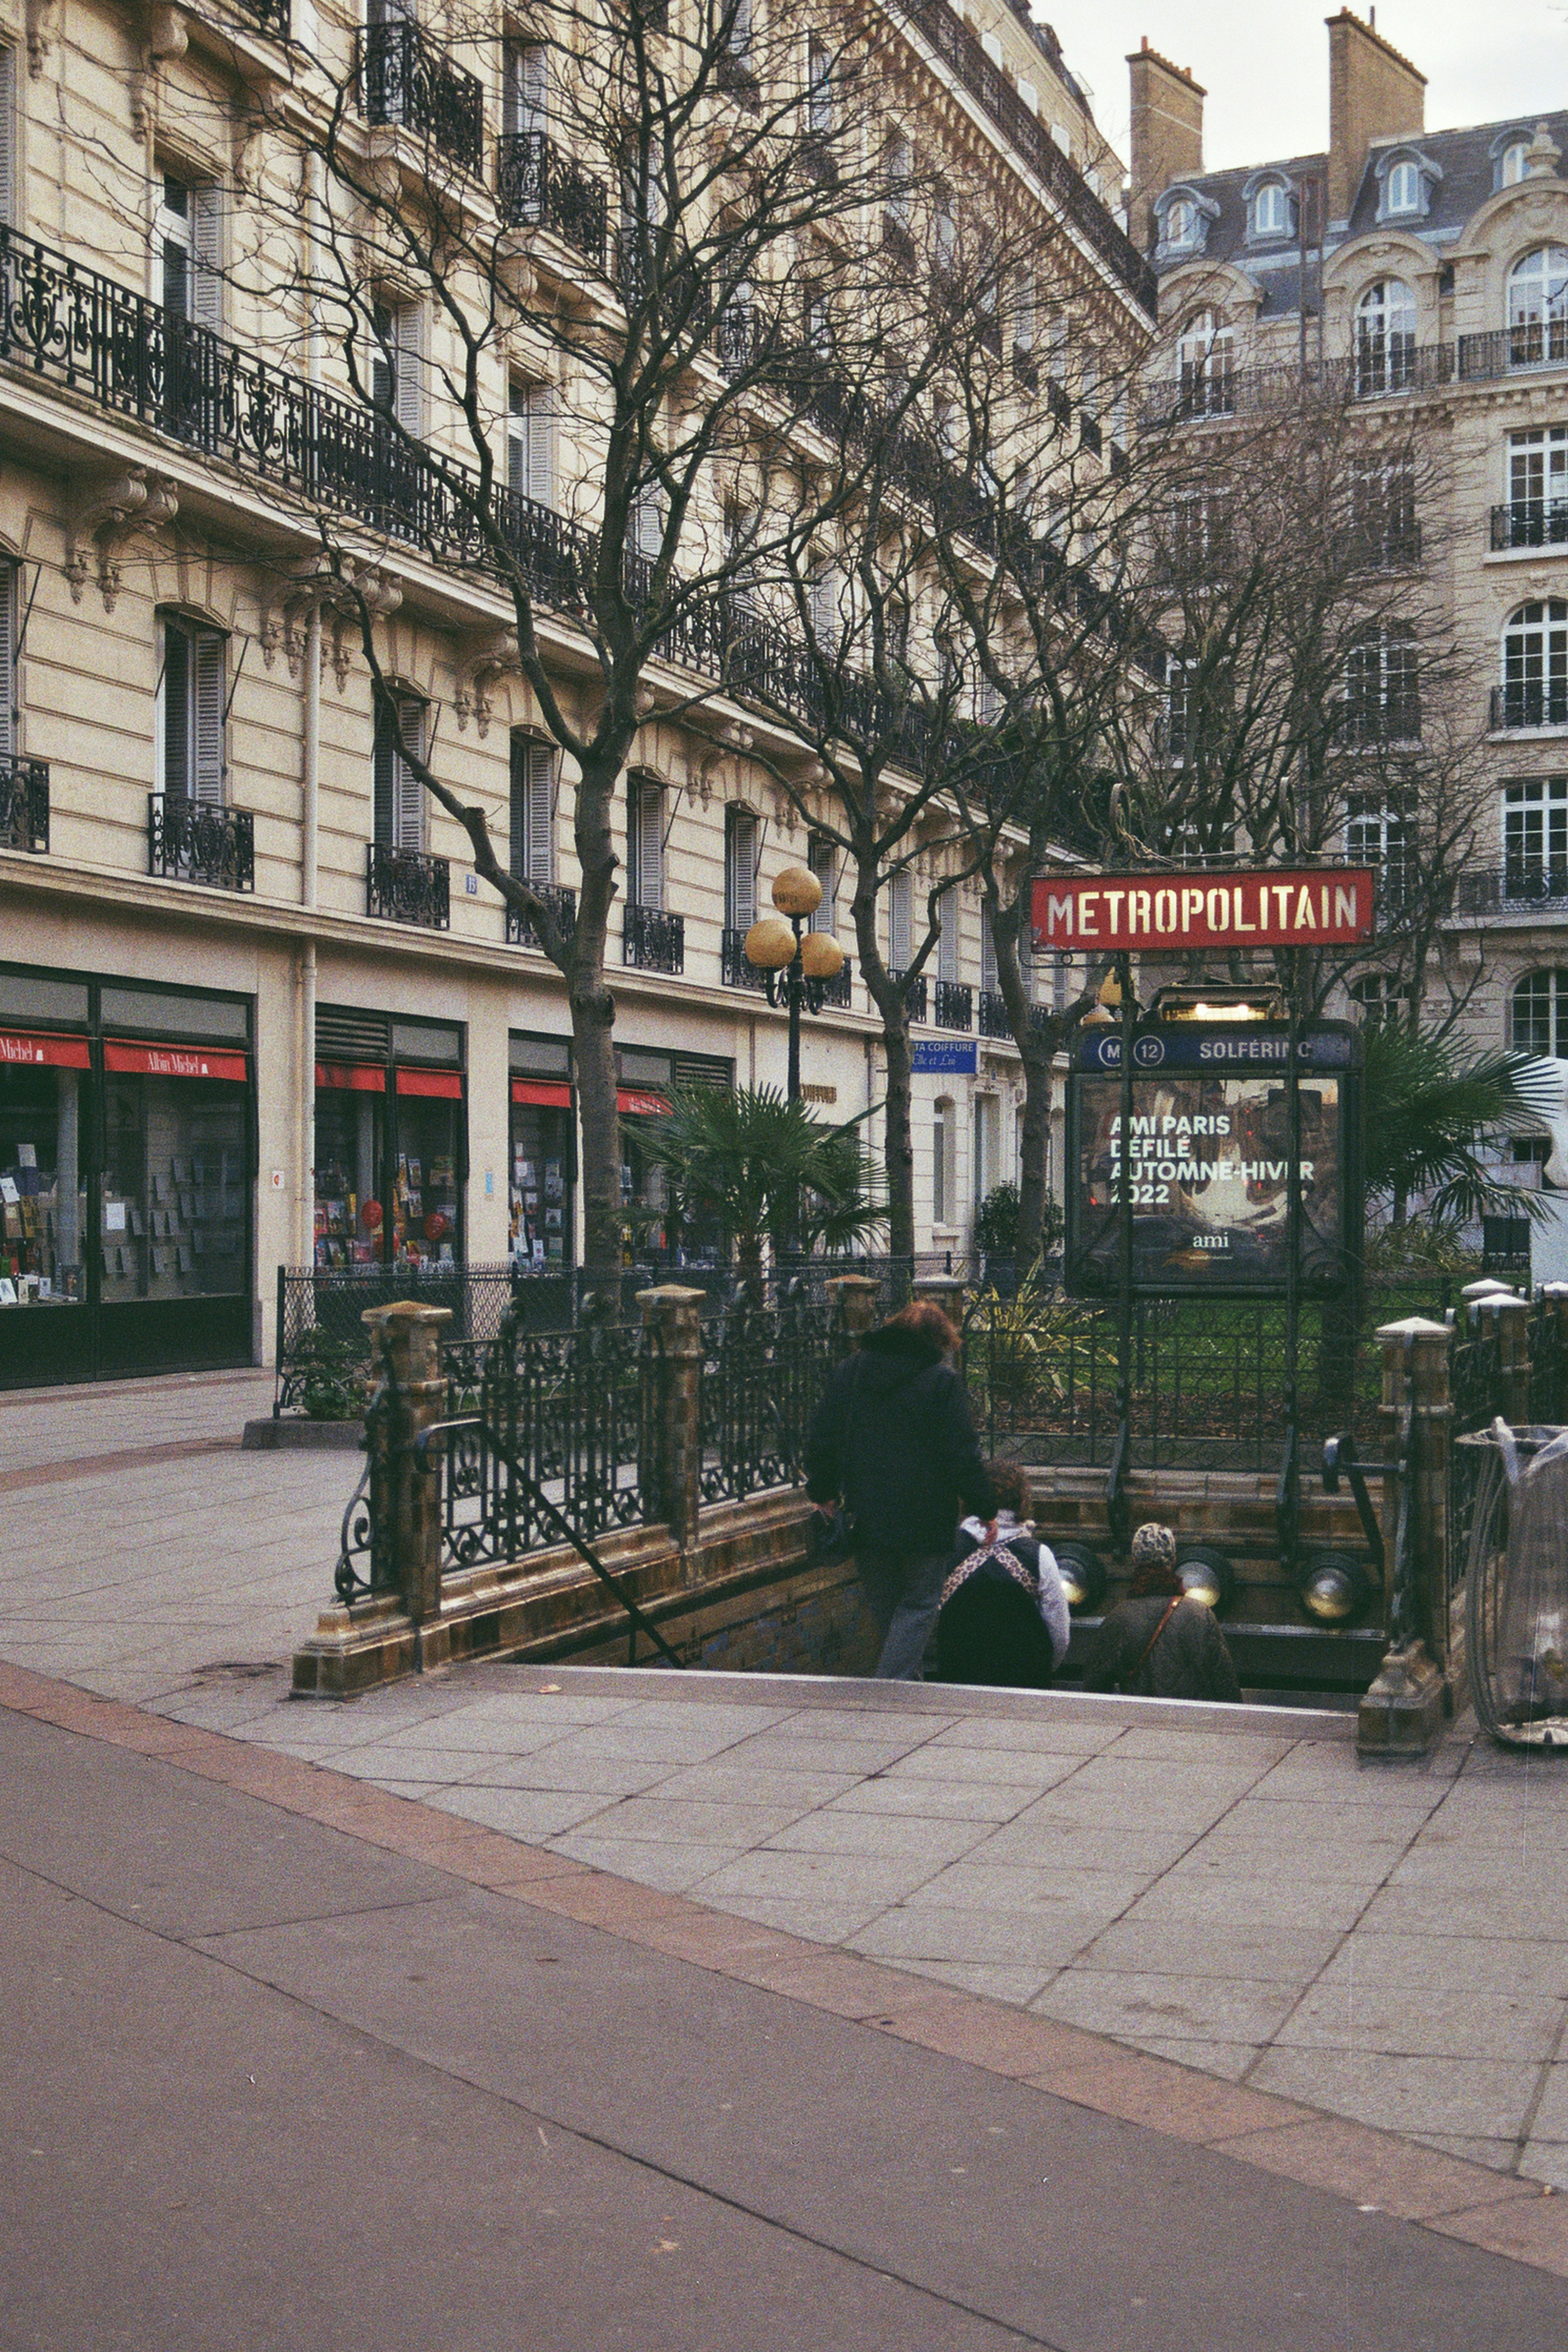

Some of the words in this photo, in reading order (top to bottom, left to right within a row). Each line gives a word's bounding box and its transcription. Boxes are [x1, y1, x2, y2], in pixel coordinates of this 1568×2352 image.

[1048, 884, 1356, 935] METROPOLITAIN
[928, 1043, 974, 1052] COIFFURE
[1141, 1044, 1158, 1058] 12
[147, 1052, 171, 1072] Albin
[171, 1054, 198, 1074] Michel
[929, 1054, 937, 1065] et
[1109, 1116, 1156, 1135] AMI
[1162, 1115, 1230, 1135] PARIS
[1110, 1136, 1191, 1158] DÉFILÉ
[1109, 1161, 1314, 1180] AUTOMNE-HIVR
[1193, 1231, 1229, 1248] ami
